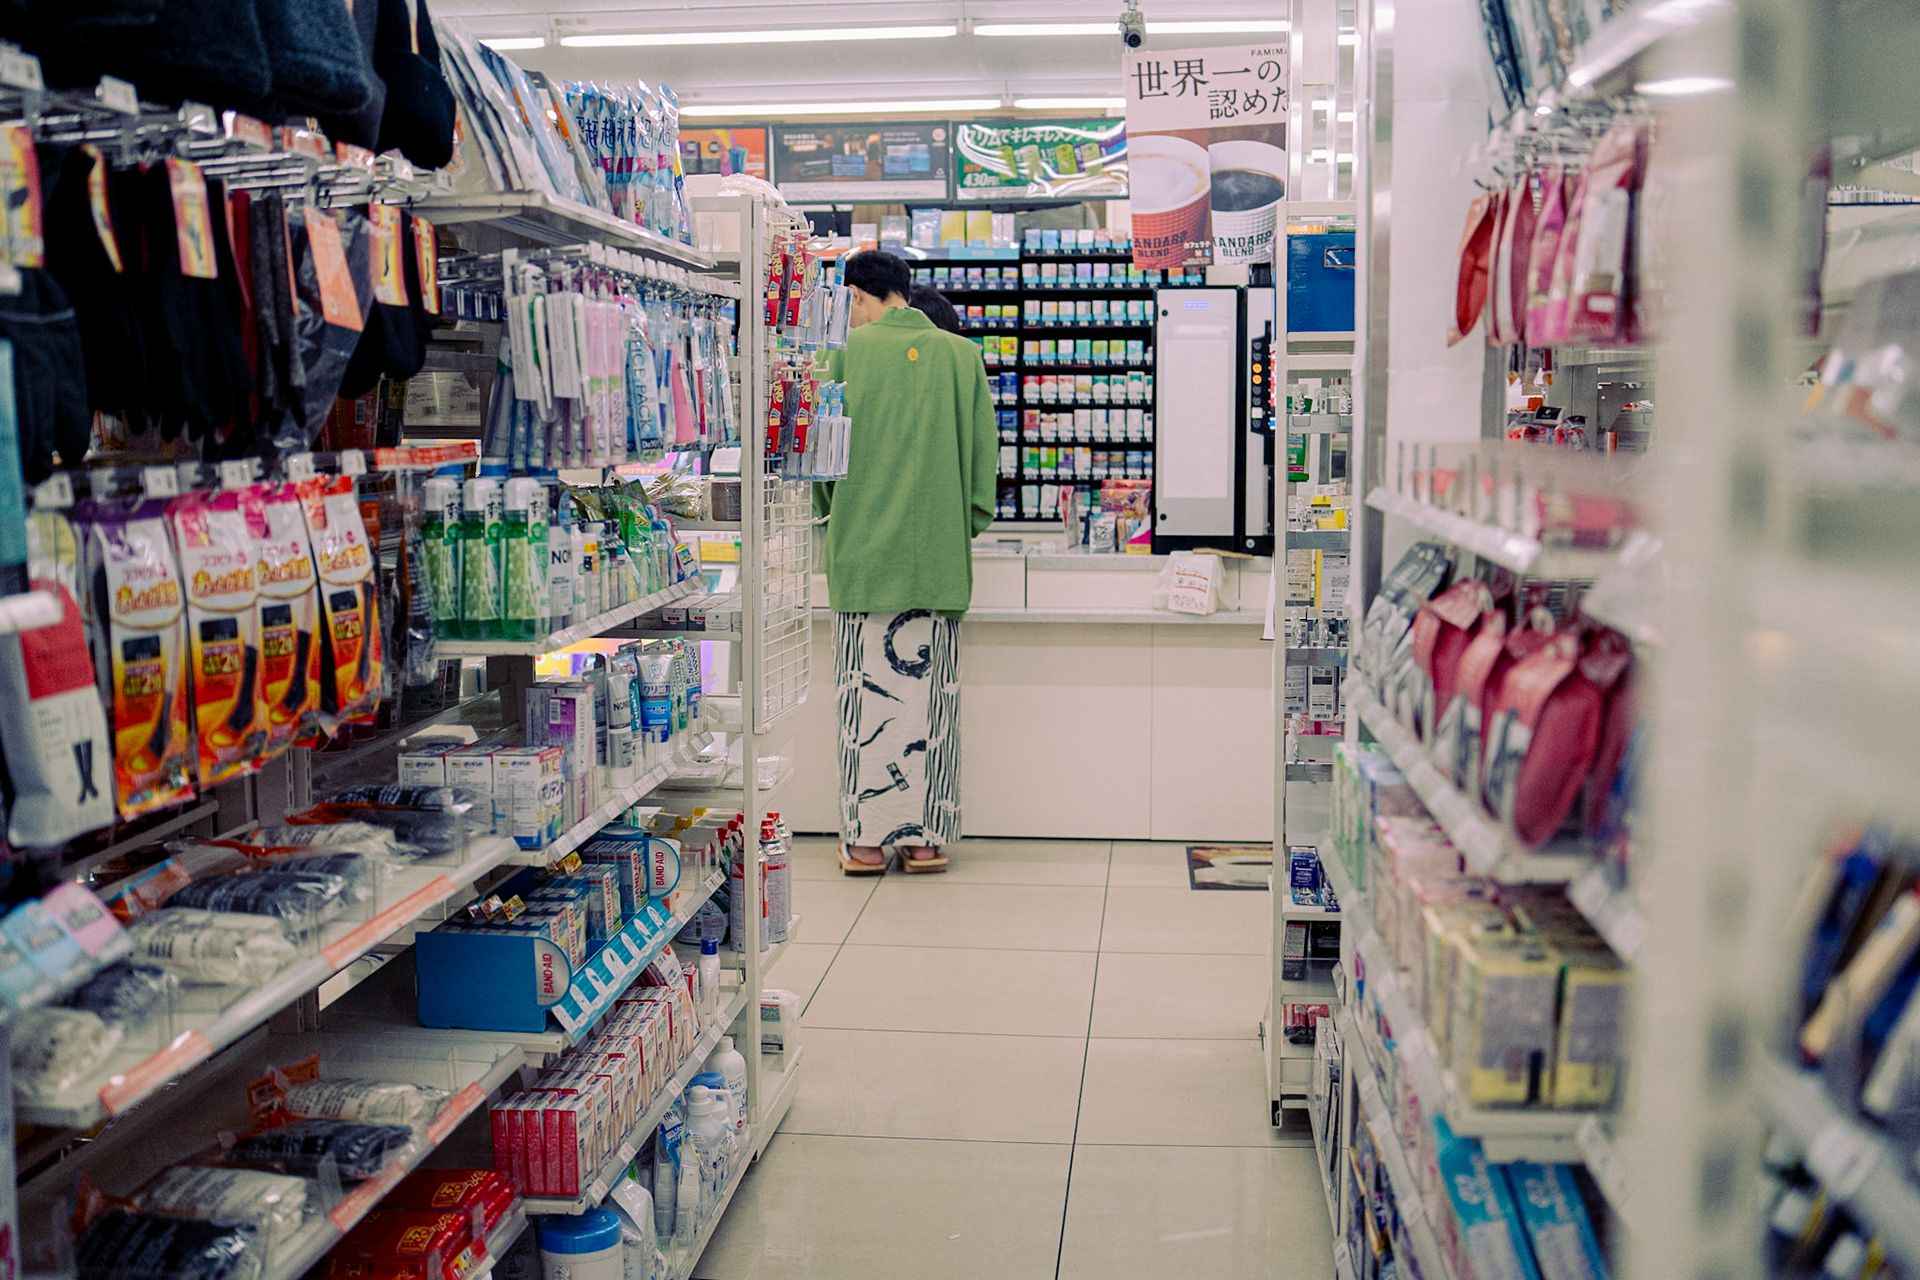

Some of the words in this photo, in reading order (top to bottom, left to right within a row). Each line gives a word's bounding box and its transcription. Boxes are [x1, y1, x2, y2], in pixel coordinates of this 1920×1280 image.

[1250, 48, 1287, 57] FAMIM
[1131, 57, 1282, 100] 世界一の
[1207, 85, 1287, 120] 認めた
[1137, 247, 1171, 258] BLEND
[1222, 246, 1255, 258] BLEND
[636, 384, 653, 430] PACK
[655, 851, 665, 887] BAND-AID
[542, 952, 555, 995] BAND-AID
